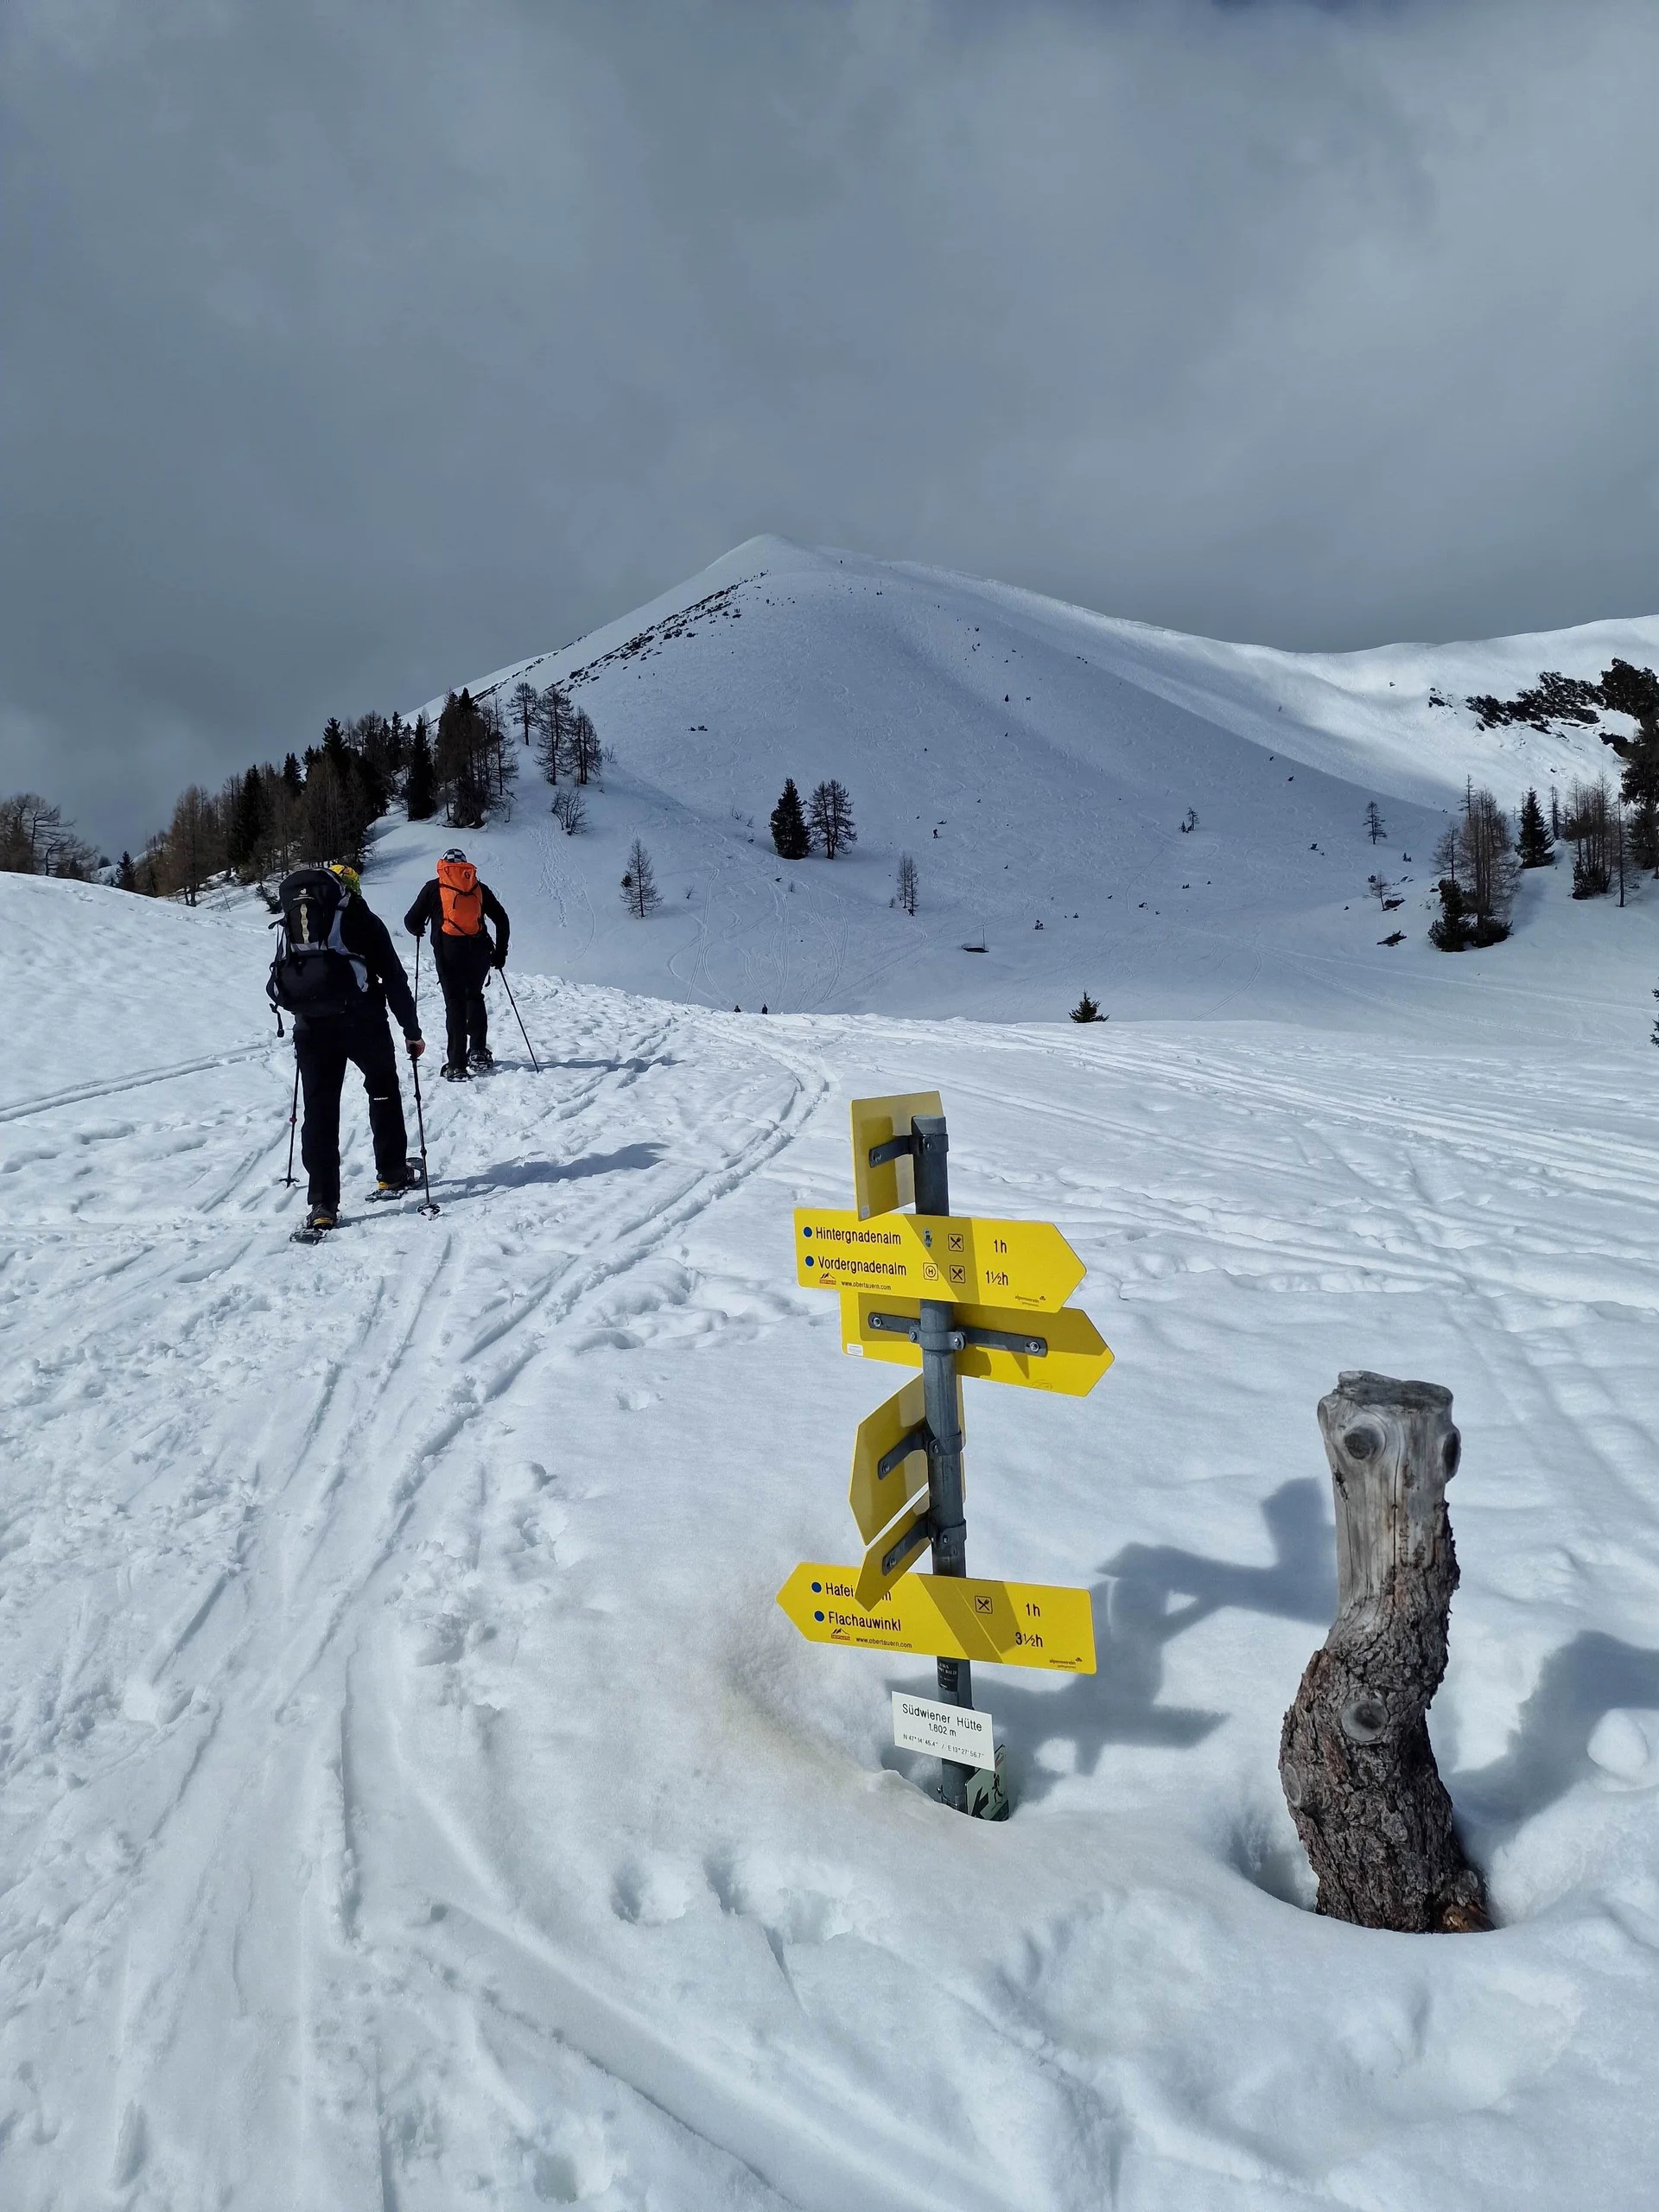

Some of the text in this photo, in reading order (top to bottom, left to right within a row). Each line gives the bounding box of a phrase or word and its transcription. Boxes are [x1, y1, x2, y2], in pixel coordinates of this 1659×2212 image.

[816, 1226, 901, 1245] Hintergnadenalm
[817, 1255, 906, 1275] Vordergnadenalm
[841, 1281, 891, 1290] www.obertauern.com
[828, 1611, 901, 1631] Flachauwinkl
[855, 1637, 912, 1649] www.obertauern.com
[902, 1703, 982, 1732] Südwiener Hütte
[928, 1723, 948, 1736] 1.802
